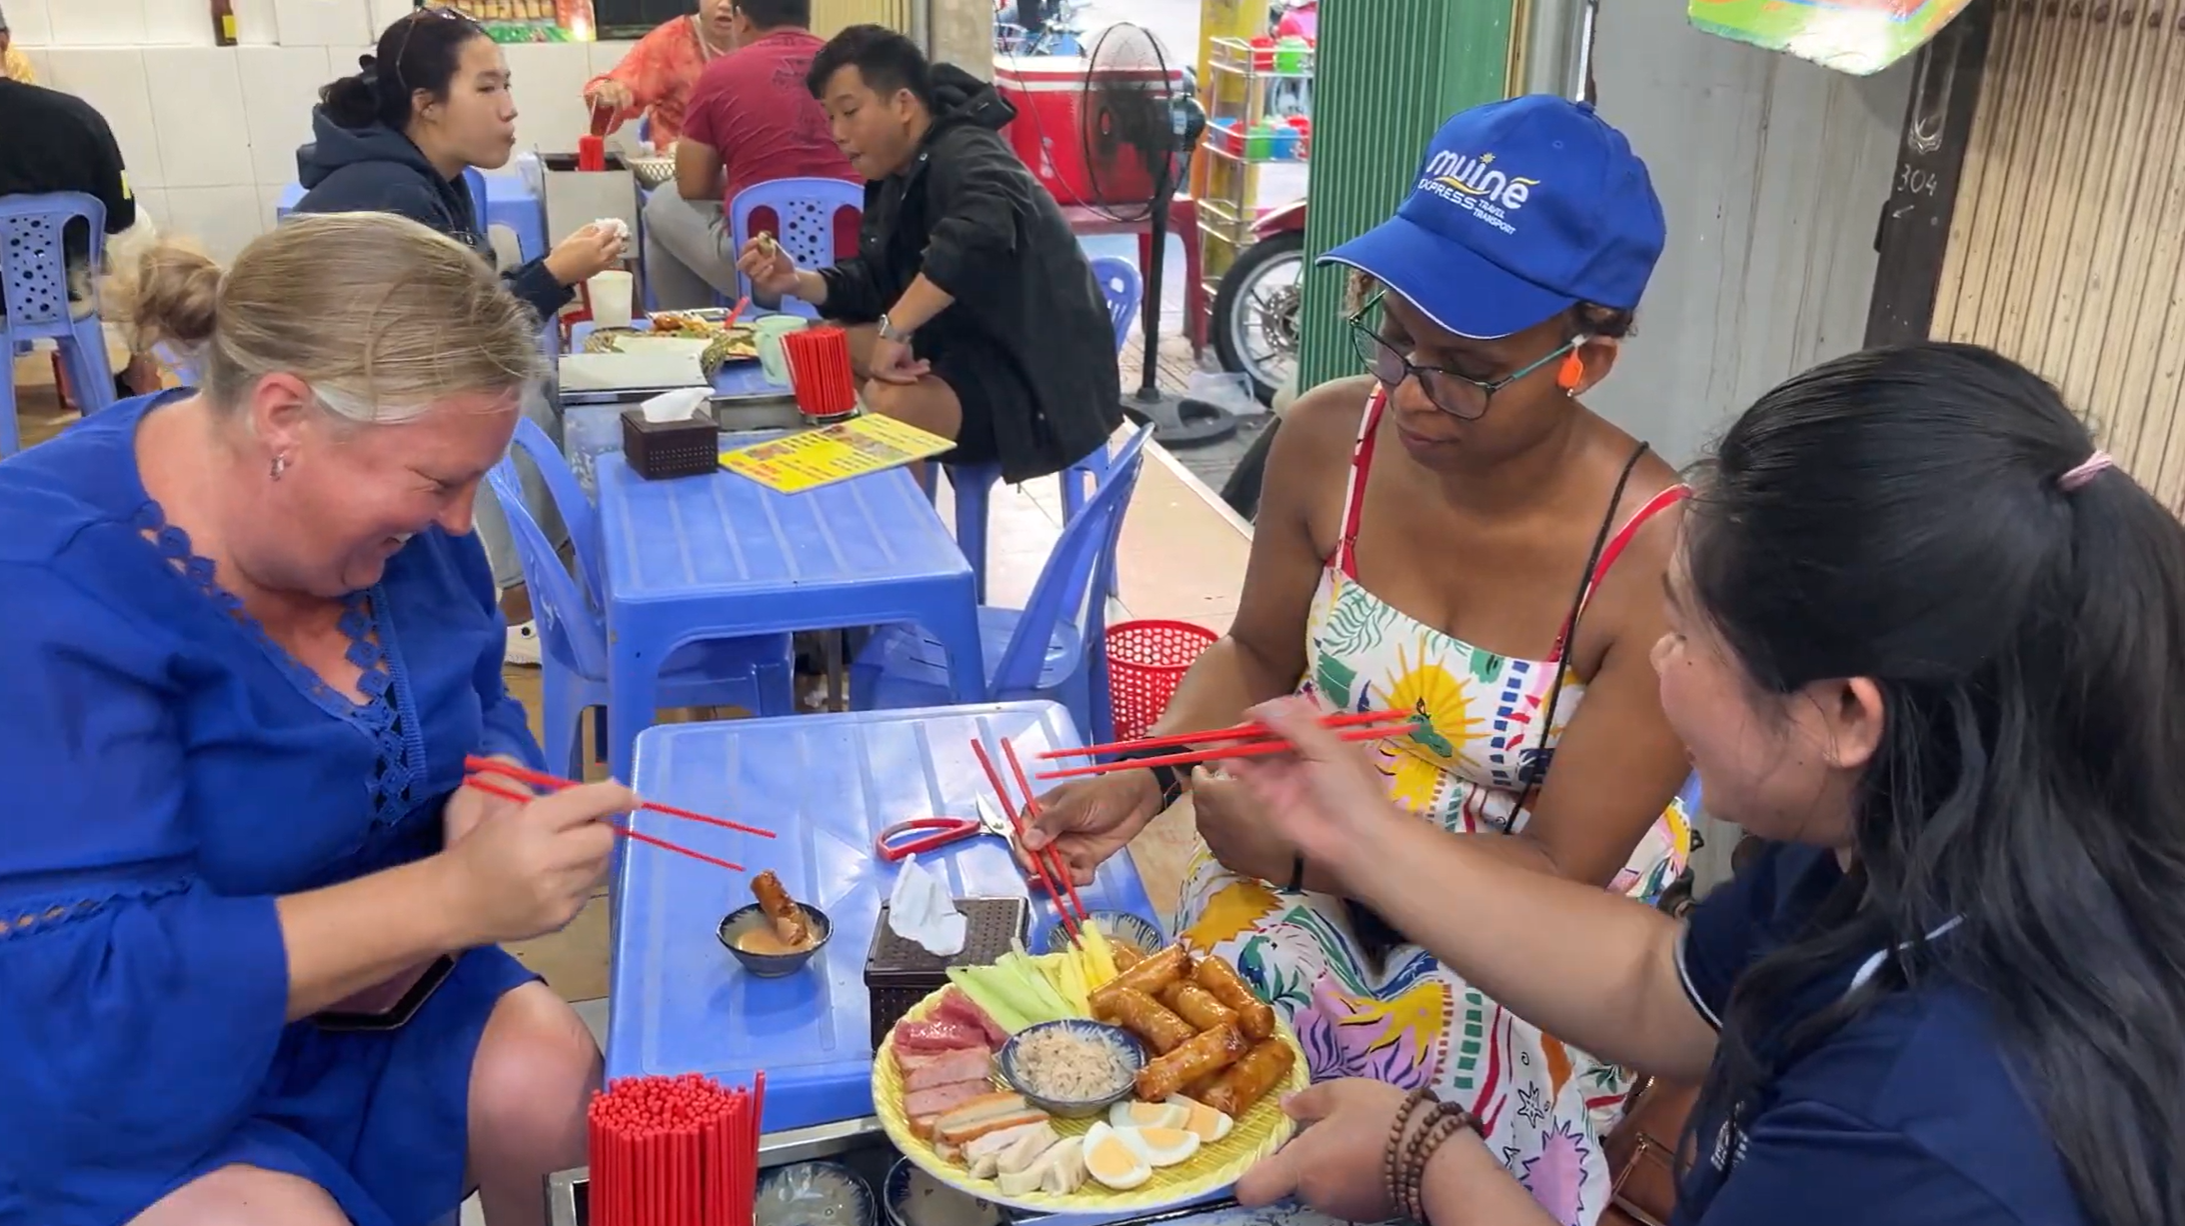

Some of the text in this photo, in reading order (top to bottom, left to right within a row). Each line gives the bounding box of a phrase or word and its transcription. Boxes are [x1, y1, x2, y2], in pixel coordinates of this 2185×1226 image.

[1897, 163, 1938, 197] 304
[1418, 178, 1506, 219] EXPRESS TRAVEL
[1472, 207, 1517, 235] TRANSPORT
